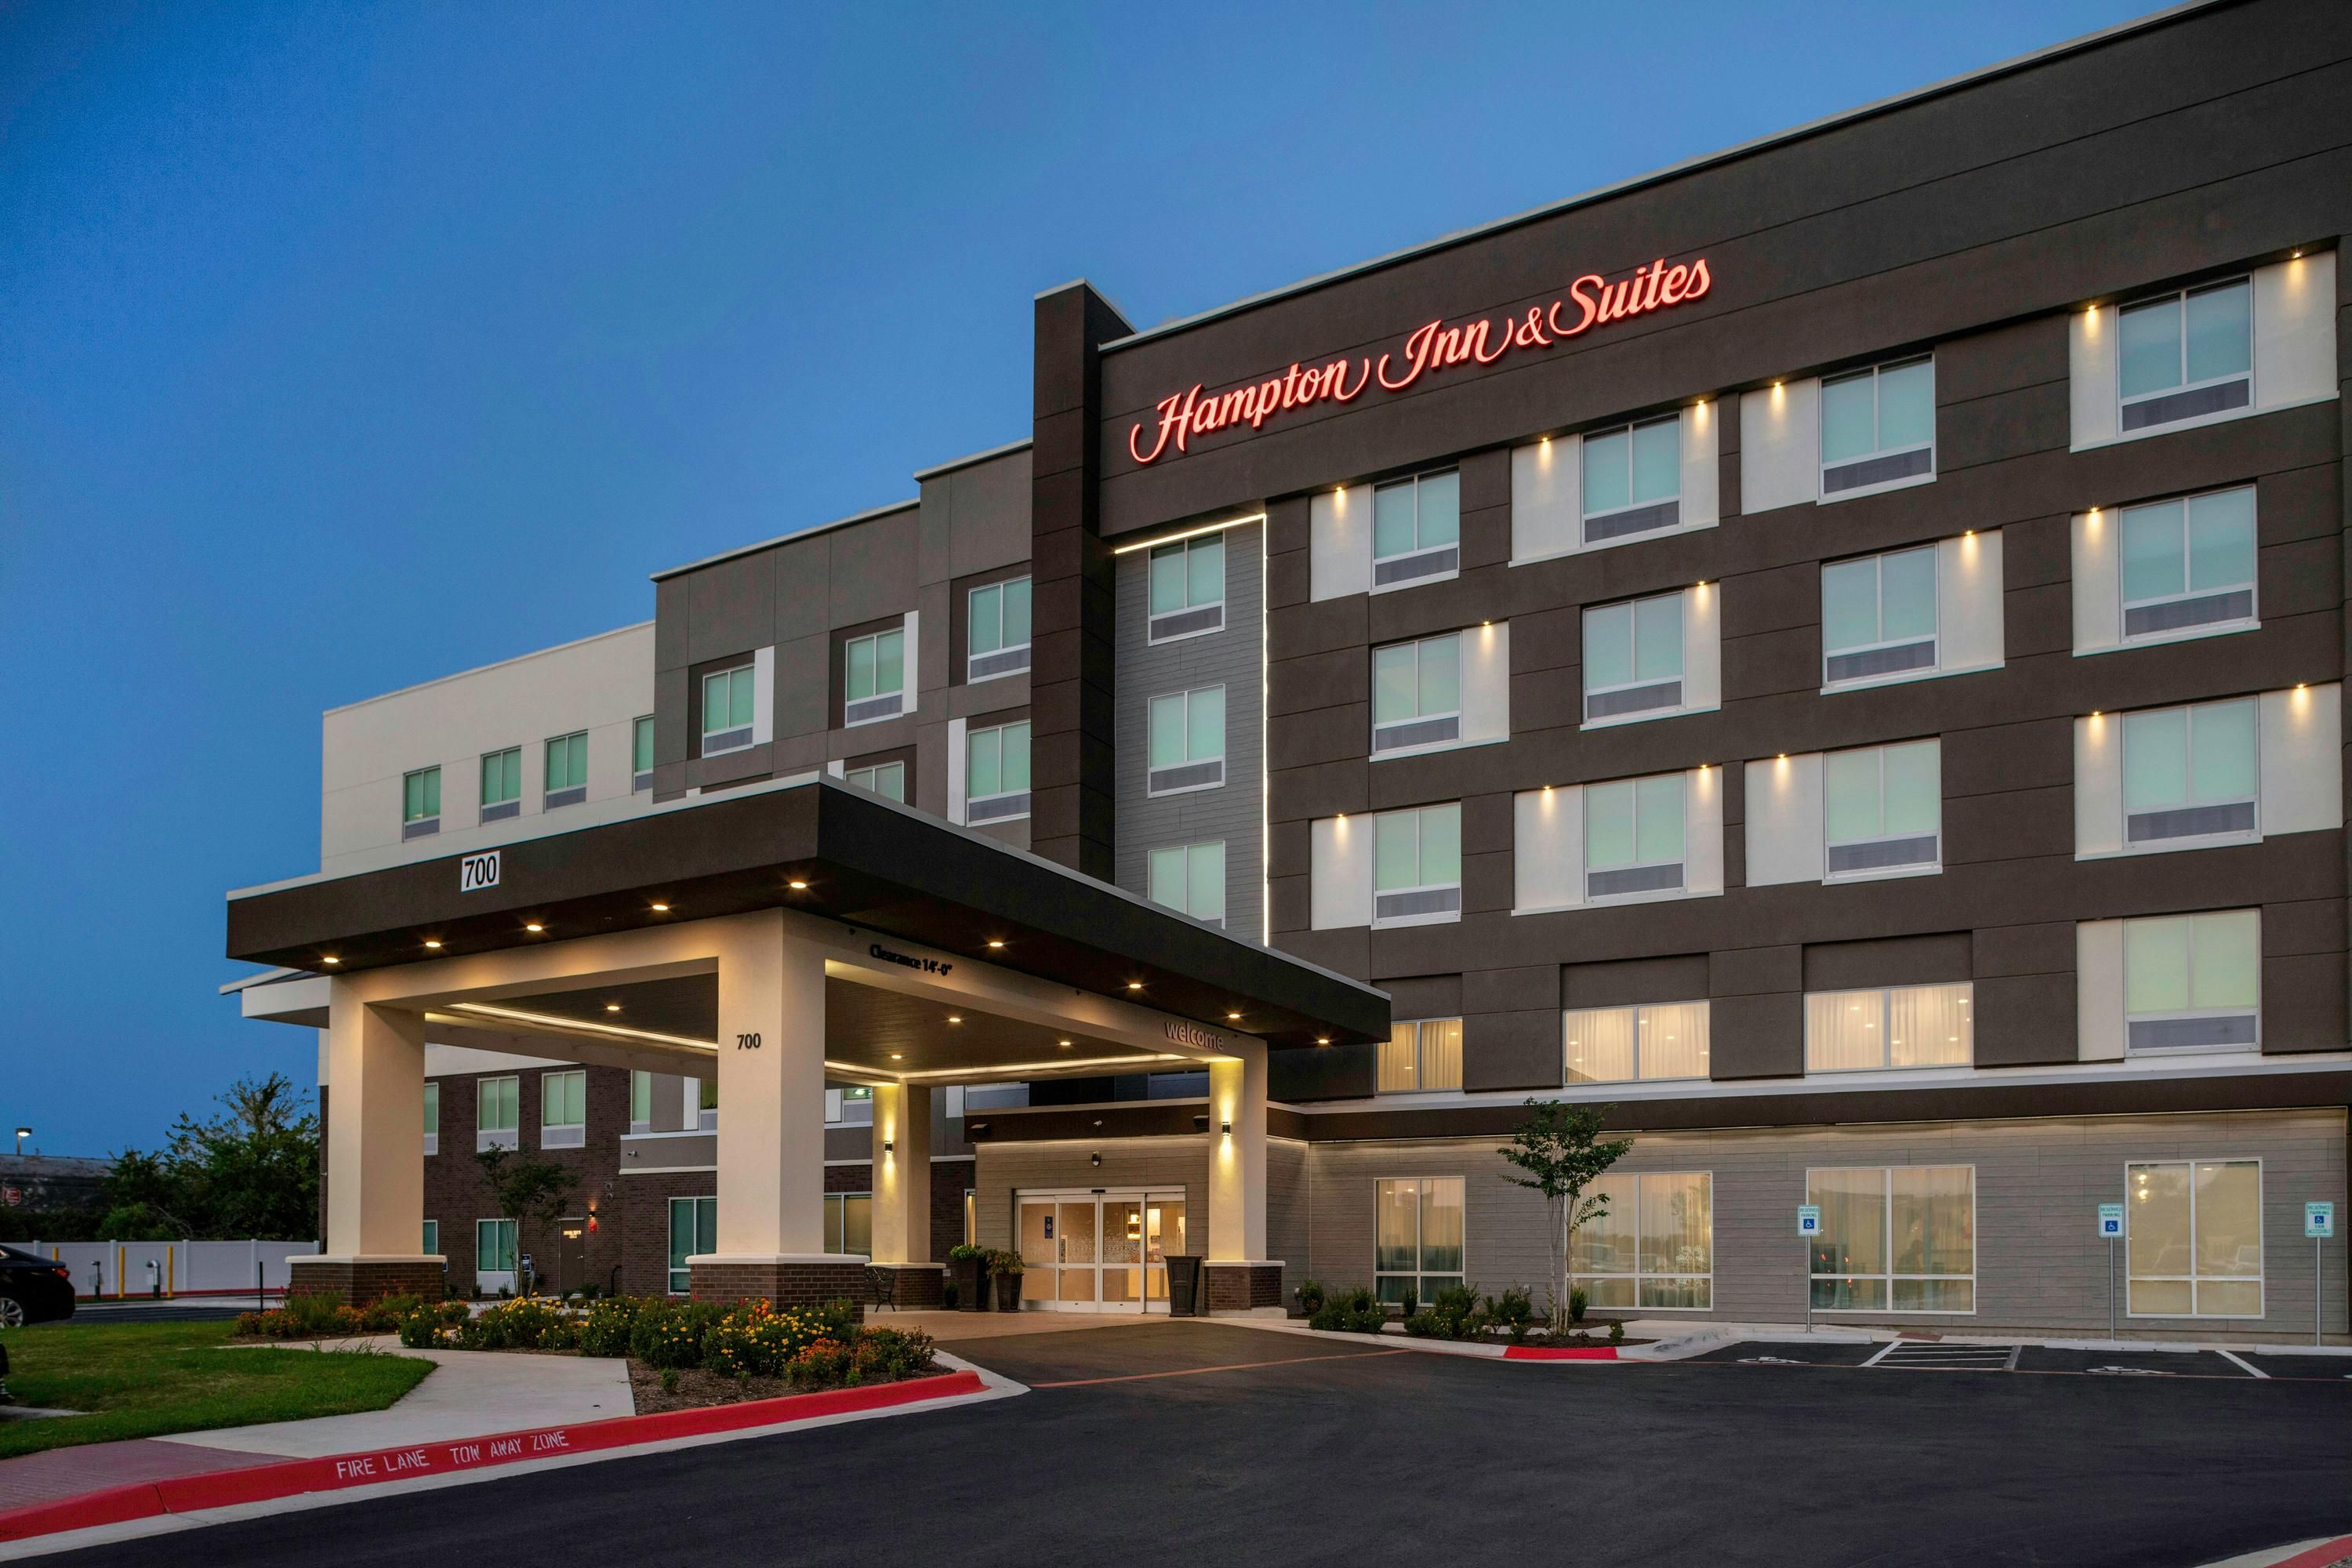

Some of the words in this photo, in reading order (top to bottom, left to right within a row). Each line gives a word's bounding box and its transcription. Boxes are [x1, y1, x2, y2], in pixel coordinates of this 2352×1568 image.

[1129, 358, 1371, 464] Hampton
[1377, 314, 1514, 390] Inn
[1515, 306, 1553, 347] &
[1548, 257, 1712, 336] Suites
[464, 855, 497, 888] 700
[869, 944, 921, 970] Clearance
[737, 1033, 761, 1050] 700
[1164, 1022, 1224, 1051] welcome
[336, 1457, 376, 1479] FIRE
[383, 1450, 430, 1472] LANE
[449, 1444, 480, 1465] TOW
[490, 1438, 522, 1458] AWAY
[529, 1431, 570, 1450] ZONE
